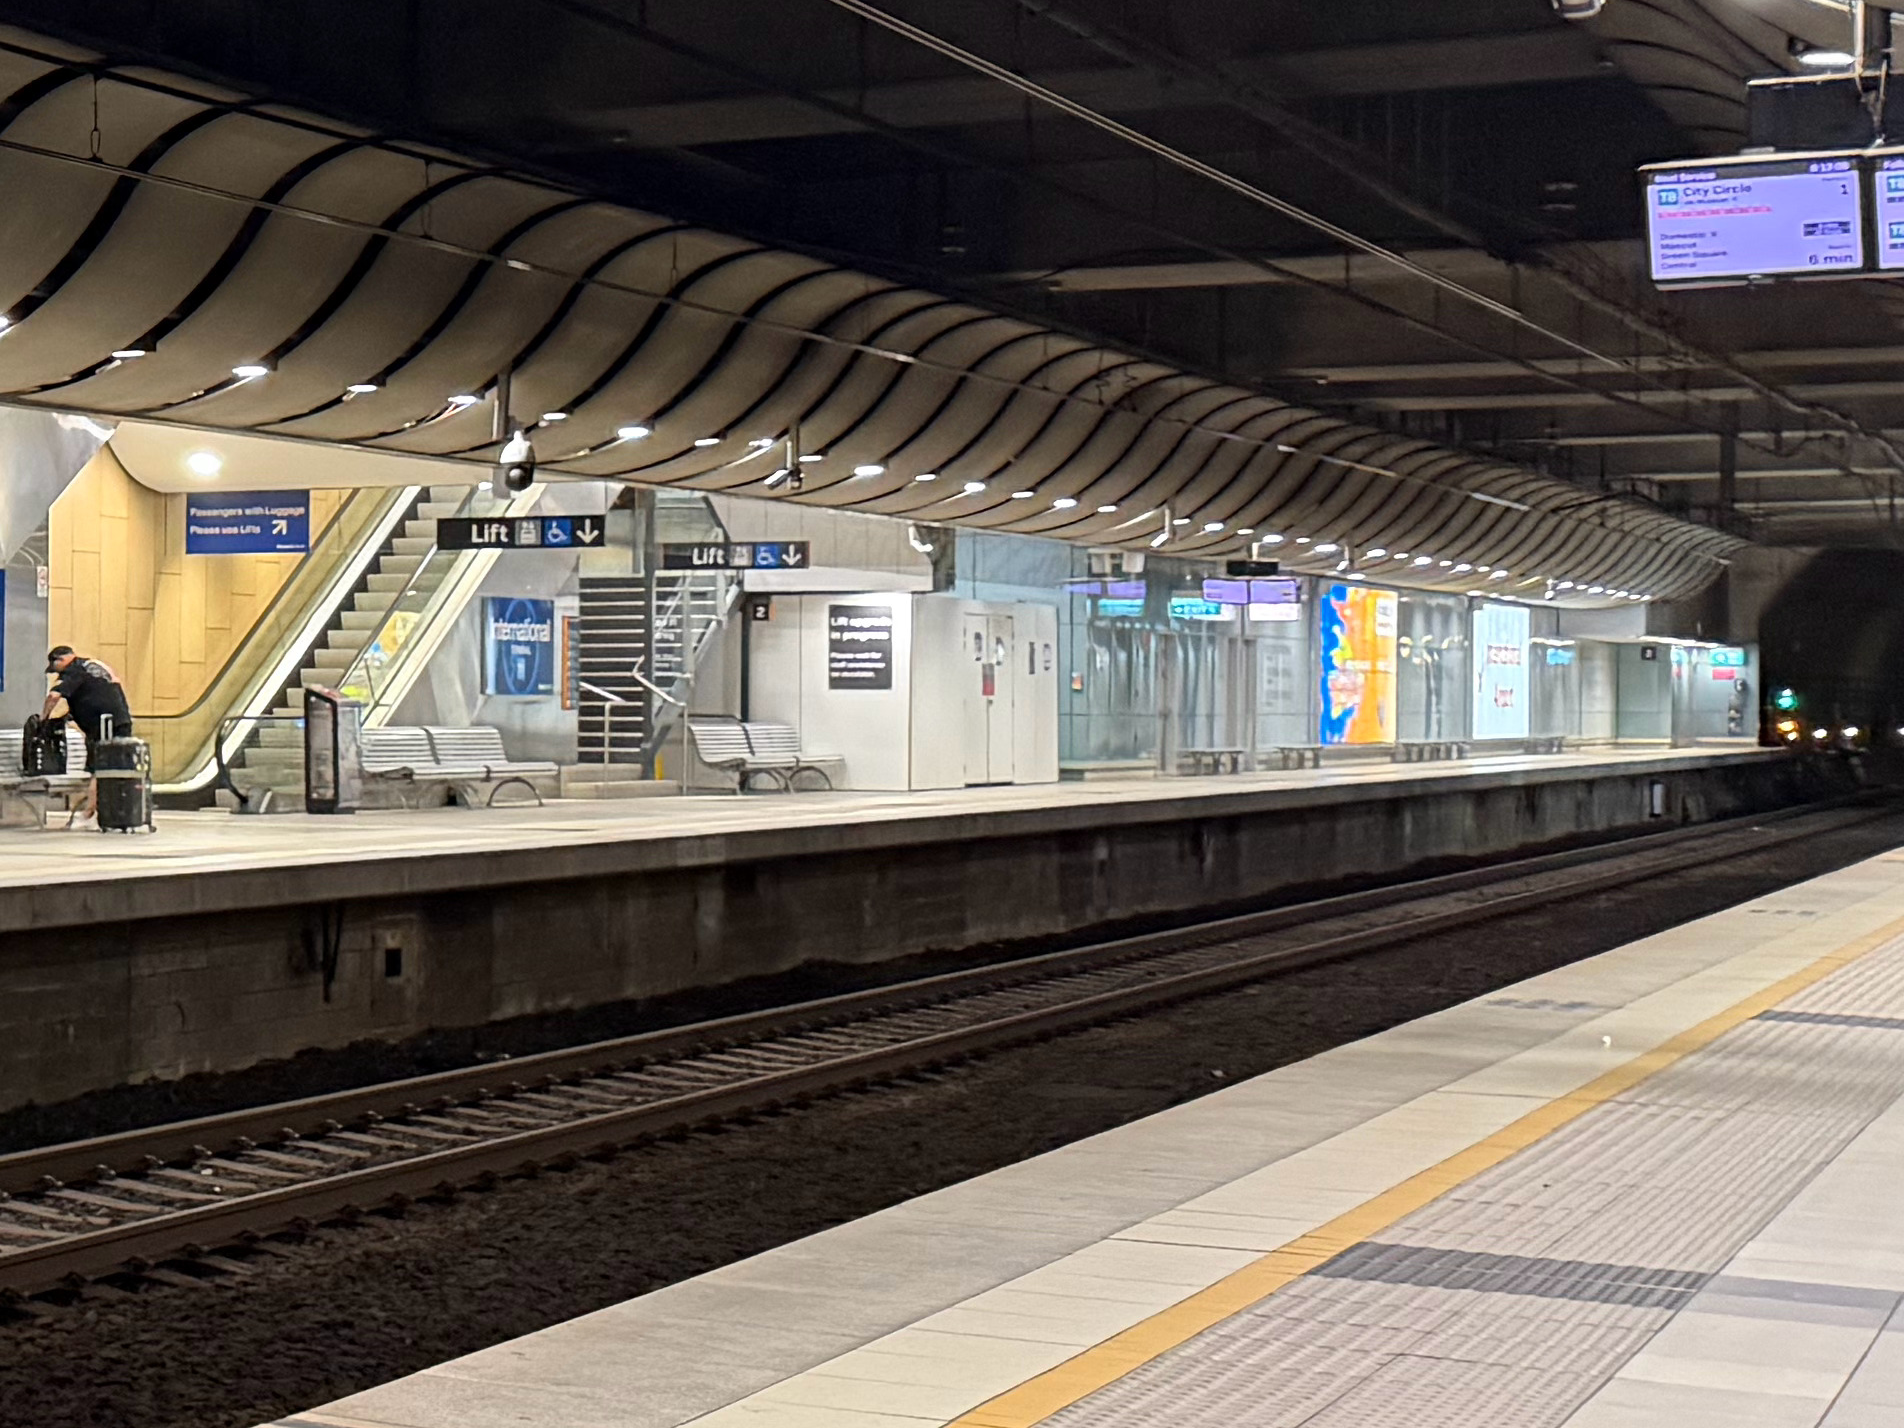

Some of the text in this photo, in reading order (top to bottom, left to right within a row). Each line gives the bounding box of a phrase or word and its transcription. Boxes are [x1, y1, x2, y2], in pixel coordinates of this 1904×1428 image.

[1683, 184, 1752, 197] City Circle
[1823, 254, 1853, 264] min
[265, 506, 306, 517] Luggage
[470, 523, 509, 543] Lift
[692, 546, 725, 565] Lift
[755, 606, 766, 618] 2
[831, 617, 849, 626] Lift
